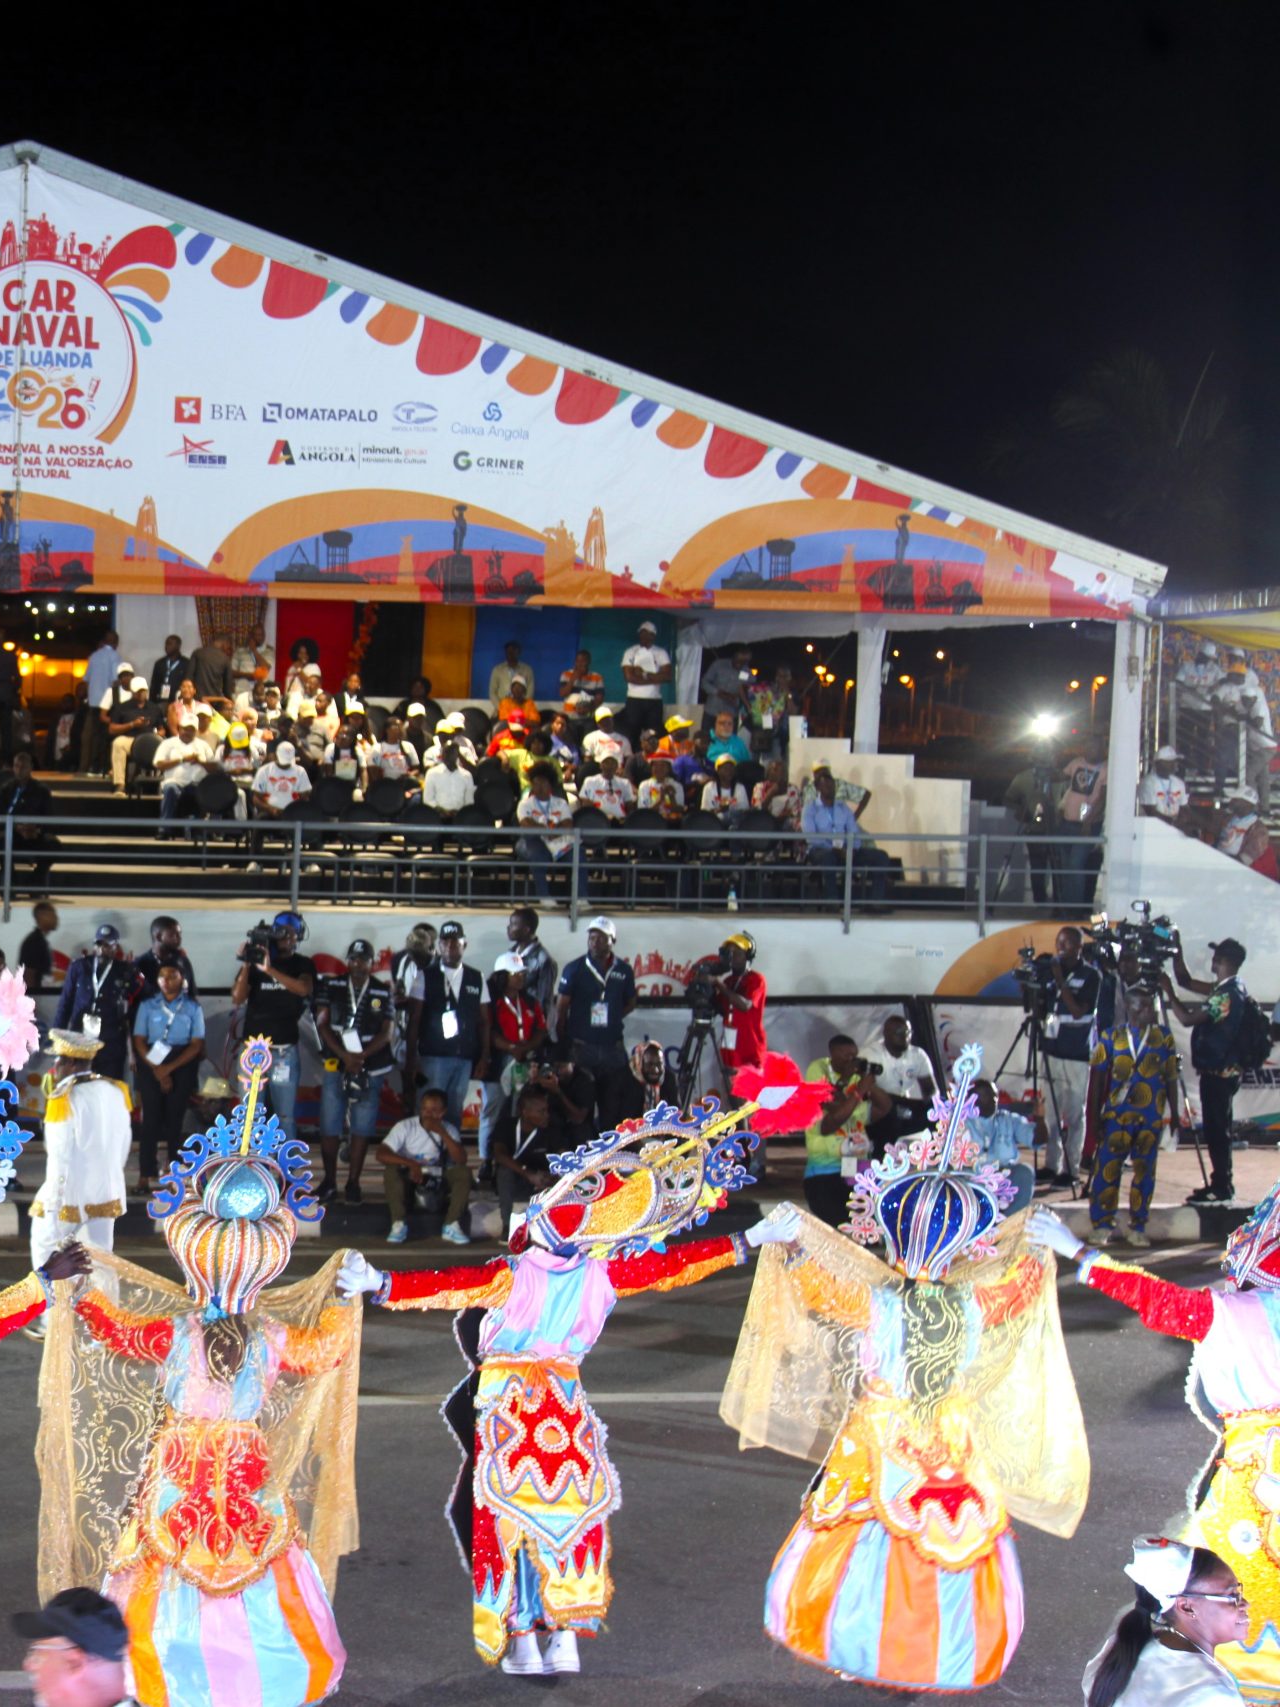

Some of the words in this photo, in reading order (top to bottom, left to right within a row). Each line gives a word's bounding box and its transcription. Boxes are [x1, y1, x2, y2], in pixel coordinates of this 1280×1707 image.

[3, 279, 76, 313] CAR
[20, 350, 93, 368] LUANDA
[210, 403, 248, 421] BFA
[285, 407, 378, 422] OMATAPALO
[451, 422, 484, 436] Caixa
[488, 424, 530, 441] Angola
[47, 444, 56, 455] A
[58, 445, 105, 456] NOSSA
[298, 452, 357, 463] ANGOLA
[24, 456, 41, 467] NA
[45, 455, 133, 470] VALORIZAÇÃO
[188, 454, 227, 465] ENSA
[476, 457, 524, 470] GRINER
[11, 467, 72, 480] CULTURAL
